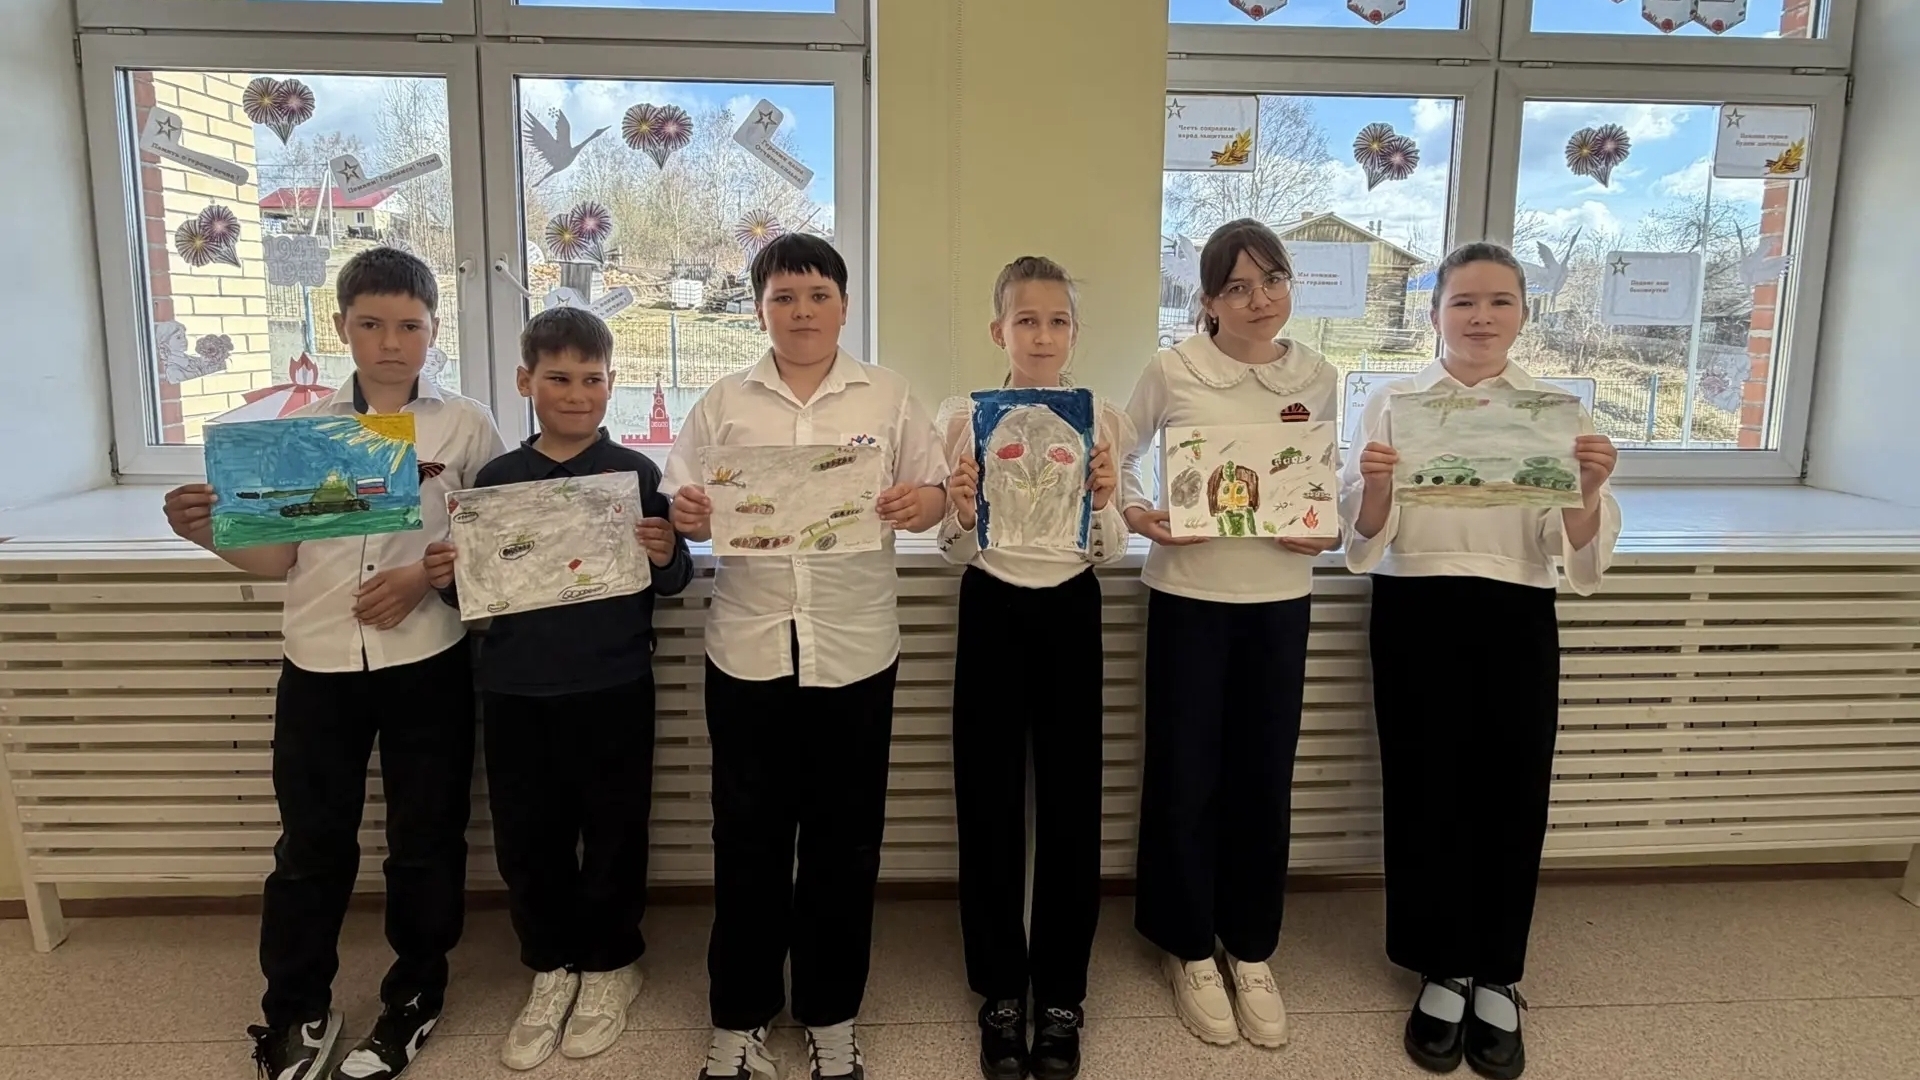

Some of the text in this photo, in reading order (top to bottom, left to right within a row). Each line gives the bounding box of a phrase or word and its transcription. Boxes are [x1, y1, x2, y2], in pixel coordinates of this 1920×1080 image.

[151, 142, 179, 158] Память
[187, 157, 212, 171] героях
[761, 139, 788, 162] Героями
[380, 165, 416, 181] Гордимся!
[416, 156, 438, 168] Чтим!
[755, 144, 804, 183] Отчизна сильна!
[270, 261, 321, 284] 1945
